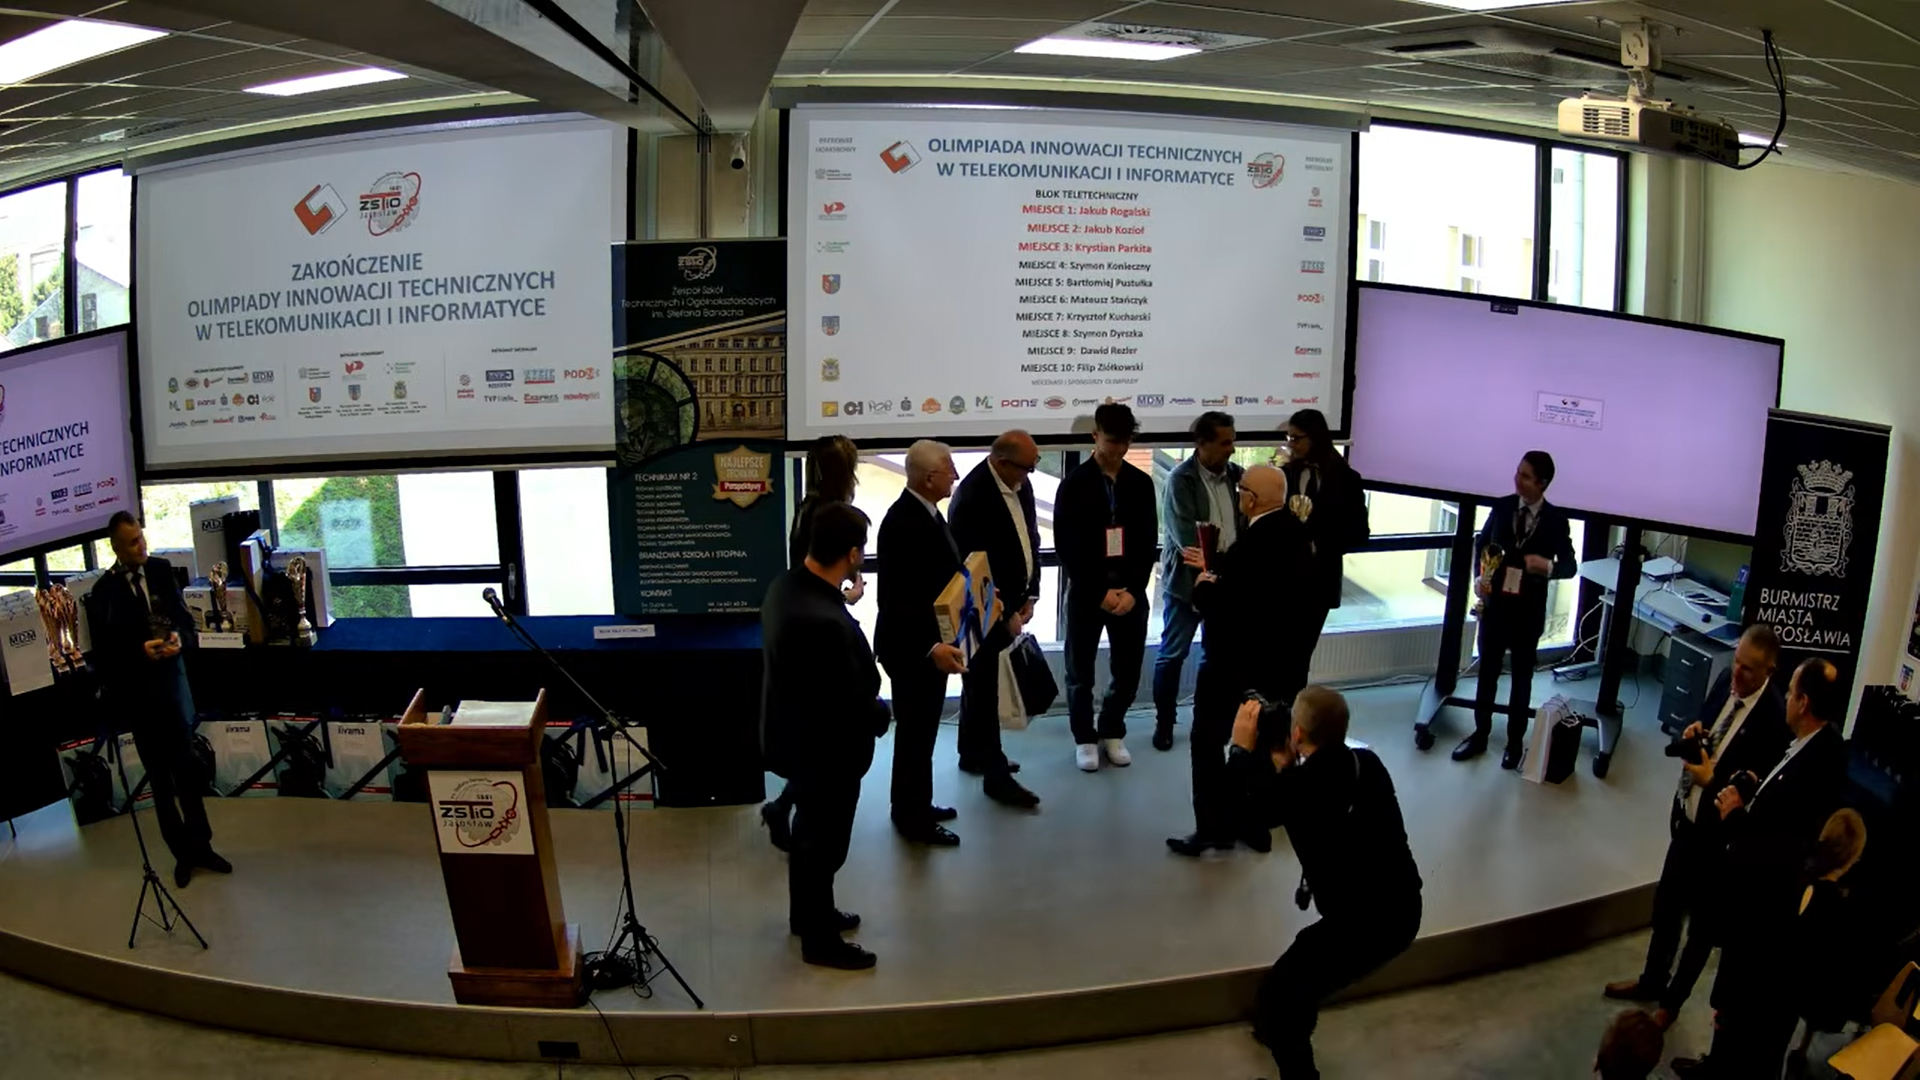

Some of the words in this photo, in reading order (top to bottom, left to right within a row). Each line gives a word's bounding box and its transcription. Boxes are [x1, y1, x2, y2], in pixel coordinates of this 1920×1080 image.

[928, 138, 1026, 154] OLIMPIADA
[1031, 141, 1123, 158] INNOWACJI
[1127, 144, 1243, 164] TECHNICZNYCH
[937, 163, 954, 177] W
[959, 163, 1112, 181] TELEKOMUNIKACJI
[1117, 167, 1121, 181] I
[1126, 168, 1235, 186] INFORMATYCE
[1036, 189, 1060, 199] BLOK
[1062, 190, 1139, 201] TELETECHNICZNY
[1022, 205, 1064, 214] MIEJSCE
[1067, 205, 1077, 215] 1:
[1079, 206, 1108, 216] Jakub
[1110, 207, 1150, 218] Rogalski
[1027, 224, 1069, 233] MIEJSCE
[1072, 224, 1081, 234] 2:
[1083, 224, 1113, 234] Jakub
[1115, 225, 1145, 235] Kozioł
[1018, 243, 1060, 251] MIEJSCE
[1063, 243, 1073, 252] 3:
[1075, 243, 1115, 254] Krystian
[1118, 243, 1152, 253] Parkita
[292, 253, 423, 282] ZAKOŃCZENIE
[1019, 261, 1056, 269] MIEJSCE
[1058, 261, 1068, 270] 4:
[1070, 261, 1105, 272] Szymon
[1107, 262, 1151, 272] Konieczny
[1015, 279, 1054, 287] MIEJSCE
[1056, 279, 1065, 288] 5:
[1066, 279, 1114, 288] Bartłomiej
[1116, 279, 1153, 288] Pustułka
[188, 291, 281, 318] OLIMPIADY
[286, 281, 392, 308] INNOWACJI
[398, 270, 556, 298] TECHNICZNYCH
[672, 285, 701, 296] Zespół
[702, 284, 724, 295] Szkół
[621, 298, 682, 308] Technicznych
[1019, 295, 1057, 304] MIEJSCE
[1059, 295, 1068, 305] 6:
[1070, 296, 1108, 304] Mateusz
[1110, 295, 1148, 305] Stańczyk
[667, 308, 701, 318] Stefana
[703, 307, 744, 317] Banacha
[1016, 313, 1054, 321] MIEJSCE
[1055, 313, 1064, 322] 7:
[1066, 312, 1107, 322] Krzysztof
[1109, 313, 1151, 322] Kucharski
[195, 323, 213, 341] W
[216, 308, 381, 340] TELEKOMUNIKACJI
[387, 307, 392, 325] I
[399, 298, 546, 324] INFORMATYCE
[1022, 330, 1060, 338] MIEJSCE
[1062, 330, 1070, 339] 8:
[1073, 329, 1108, 340] Szymon
[1027, 347, 1065, 355] MIEJSCE
[1067, 347, 1076, 356] 9:
[1080, 346, 1109, 355] Dawid
[1020, 364, 1059, 372] MIEJSCE
[1061, 364, 1074, 373] 10:
[1077, 363, 1096, 373] Filip
[1097, 362, 1144, 372] Ziółkowski
[1138, 395, 1164, 406] MDM
[0, 421, 90, 455] ECHNICZNYCH
[720, 456, 765, 469] NAJLEPSZE
[634, 472, 679, 482] TECHNIKUM
[680, 473, 691, 481] NR
[692, 471, 698, 481] 2
[202, 519, 223, 531] MD
[638, 551, 681, 560] BRANŻOWA
[682, 550, 711, 559] SZKOŁA
[715, 550, 748, 558] STOPNIA
[1760, 588, 1841, 611] BURMISTRZ
[1757, 607, 1814, 626] MIASTA
[9, 629, 37, 646] MDM
[1773, 625, 1850, 647] ROSŁAWIA
[440, 803, 494, 819] ZSTiO
